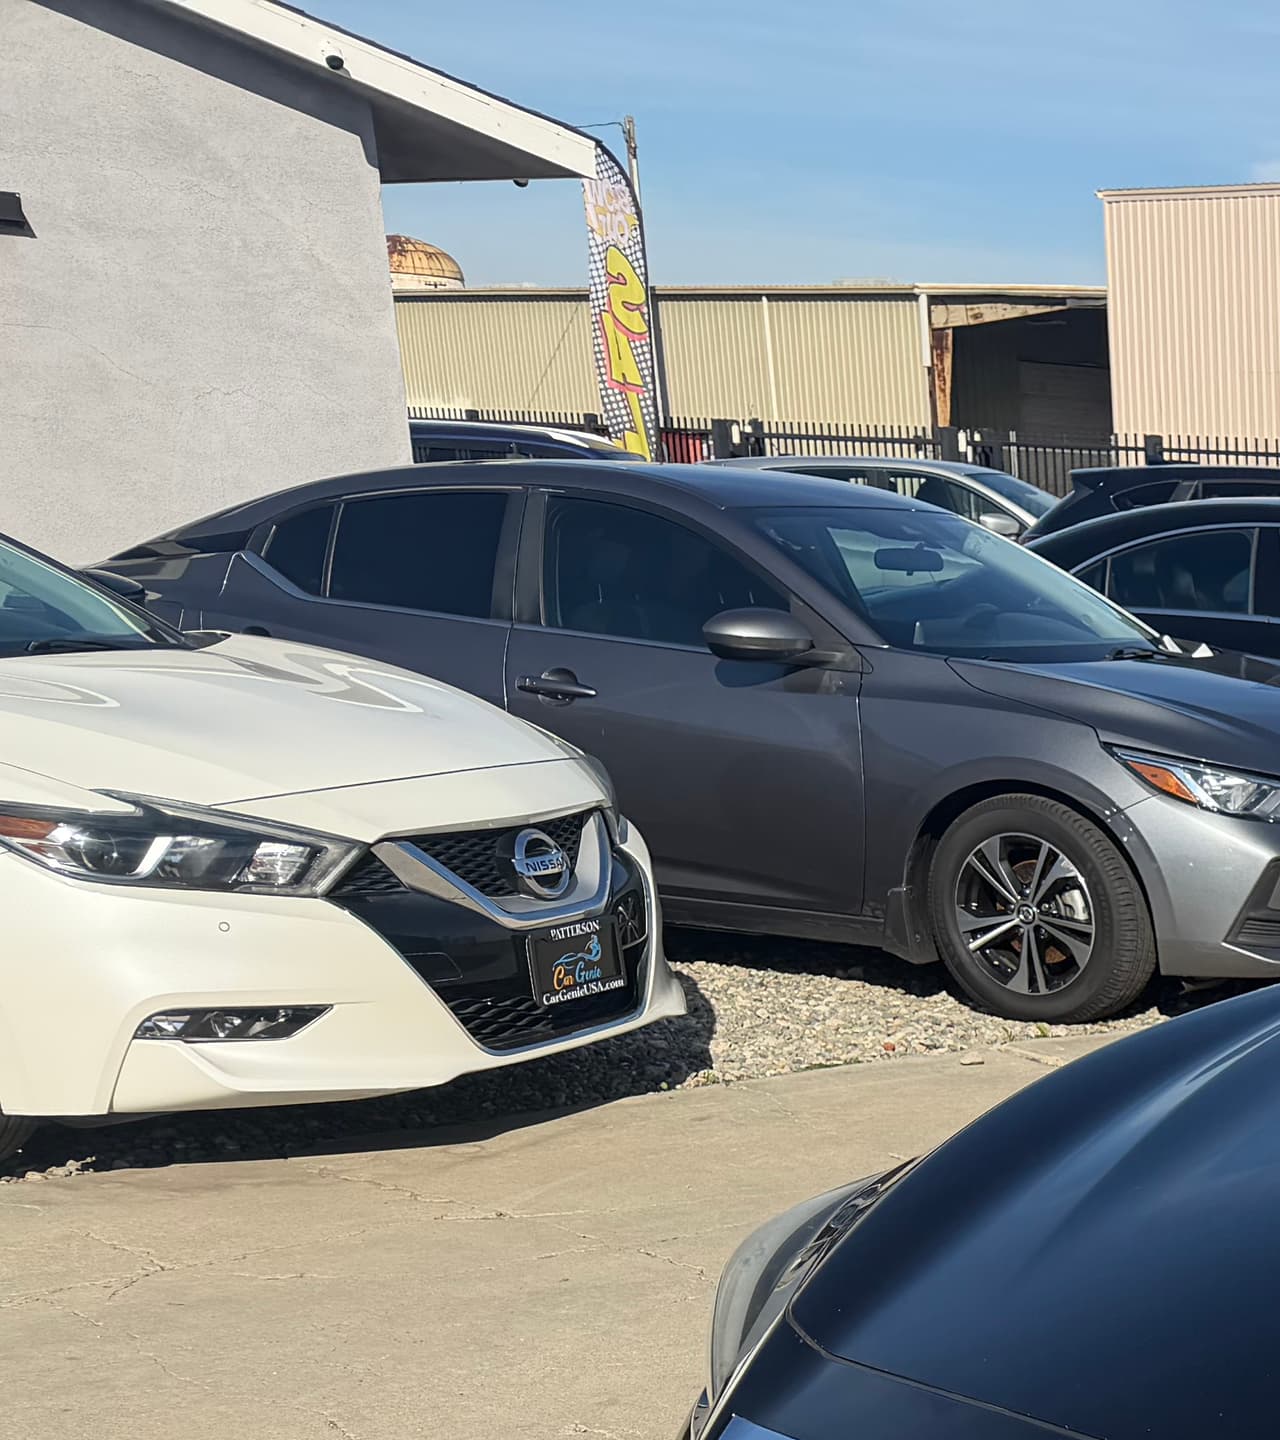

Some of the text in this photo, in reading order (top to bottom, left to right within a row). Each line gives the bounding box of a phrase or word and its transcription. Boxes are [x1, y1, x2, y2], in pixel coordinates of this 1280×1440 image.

[525, 858, 564, 872] NISSA
[550, 920, 600, 941] PATTERSON
[553, 961, 602, 990] Car Genie
[542, 979, 625, 1005] CarGenieUSA.com
